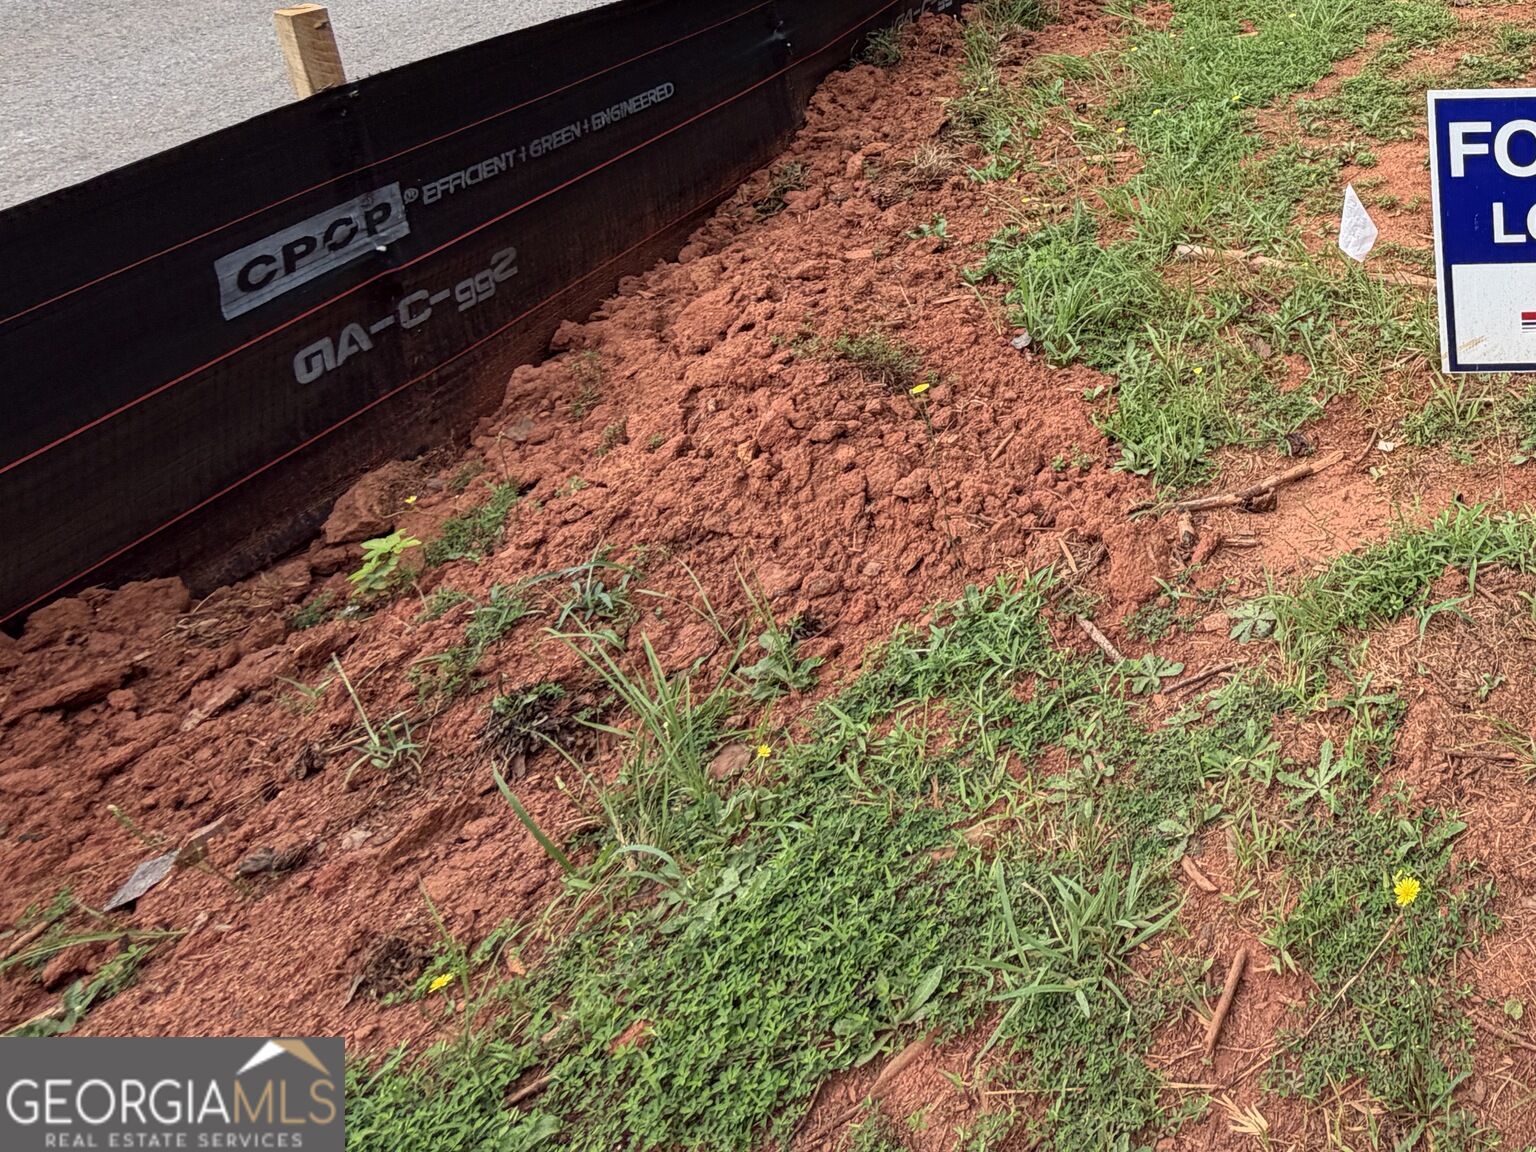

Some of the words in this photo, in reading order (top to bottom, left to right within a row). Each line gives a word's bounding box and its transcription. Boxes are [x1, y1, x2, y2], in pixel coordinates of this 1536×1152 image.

[422, 148, 517, 206] EFFICIENT
[529, 121, 582, 158] GREEN
[591, 82, 675, 132] ENGINEERED
